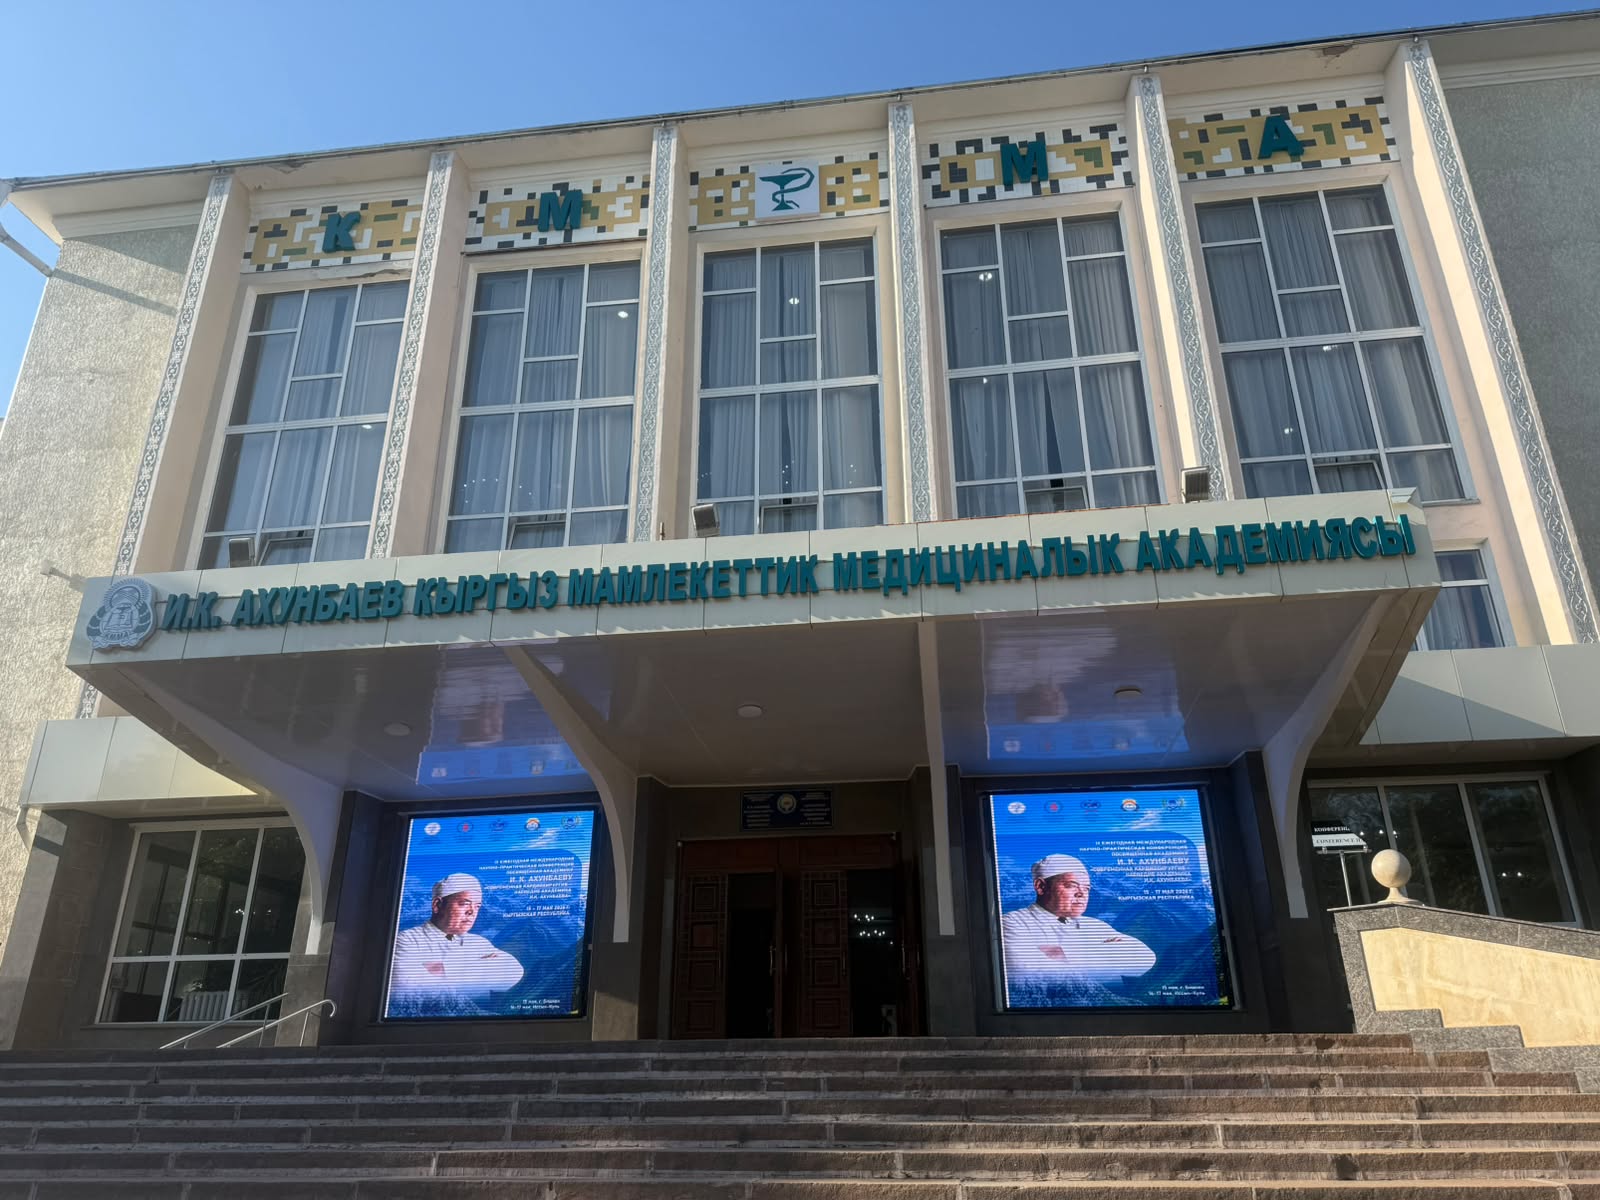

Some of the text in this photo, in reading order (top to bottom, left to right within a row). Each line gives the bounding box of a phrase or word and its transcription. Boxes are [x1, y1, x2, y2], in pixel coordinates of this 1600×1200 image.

[321, 114, 1305, 253] К М М А
[231, 579, 405, 627] АХУНБАЕВ
[412, 569, 559, 617] КЫРГЫЗ
[567, 554, 819, 607] МАМЛЕКЕТТИК
[832, 533, 1125, 597] МЕДИЦИНАЛЫК
[1136, 514, 1417, 576] АКАДЕМИЯСЫ
[528, 874, 574, 882] АХУНБАЕВУ
[1138, 857, 1190, 865] АХУНБАЕВУ
